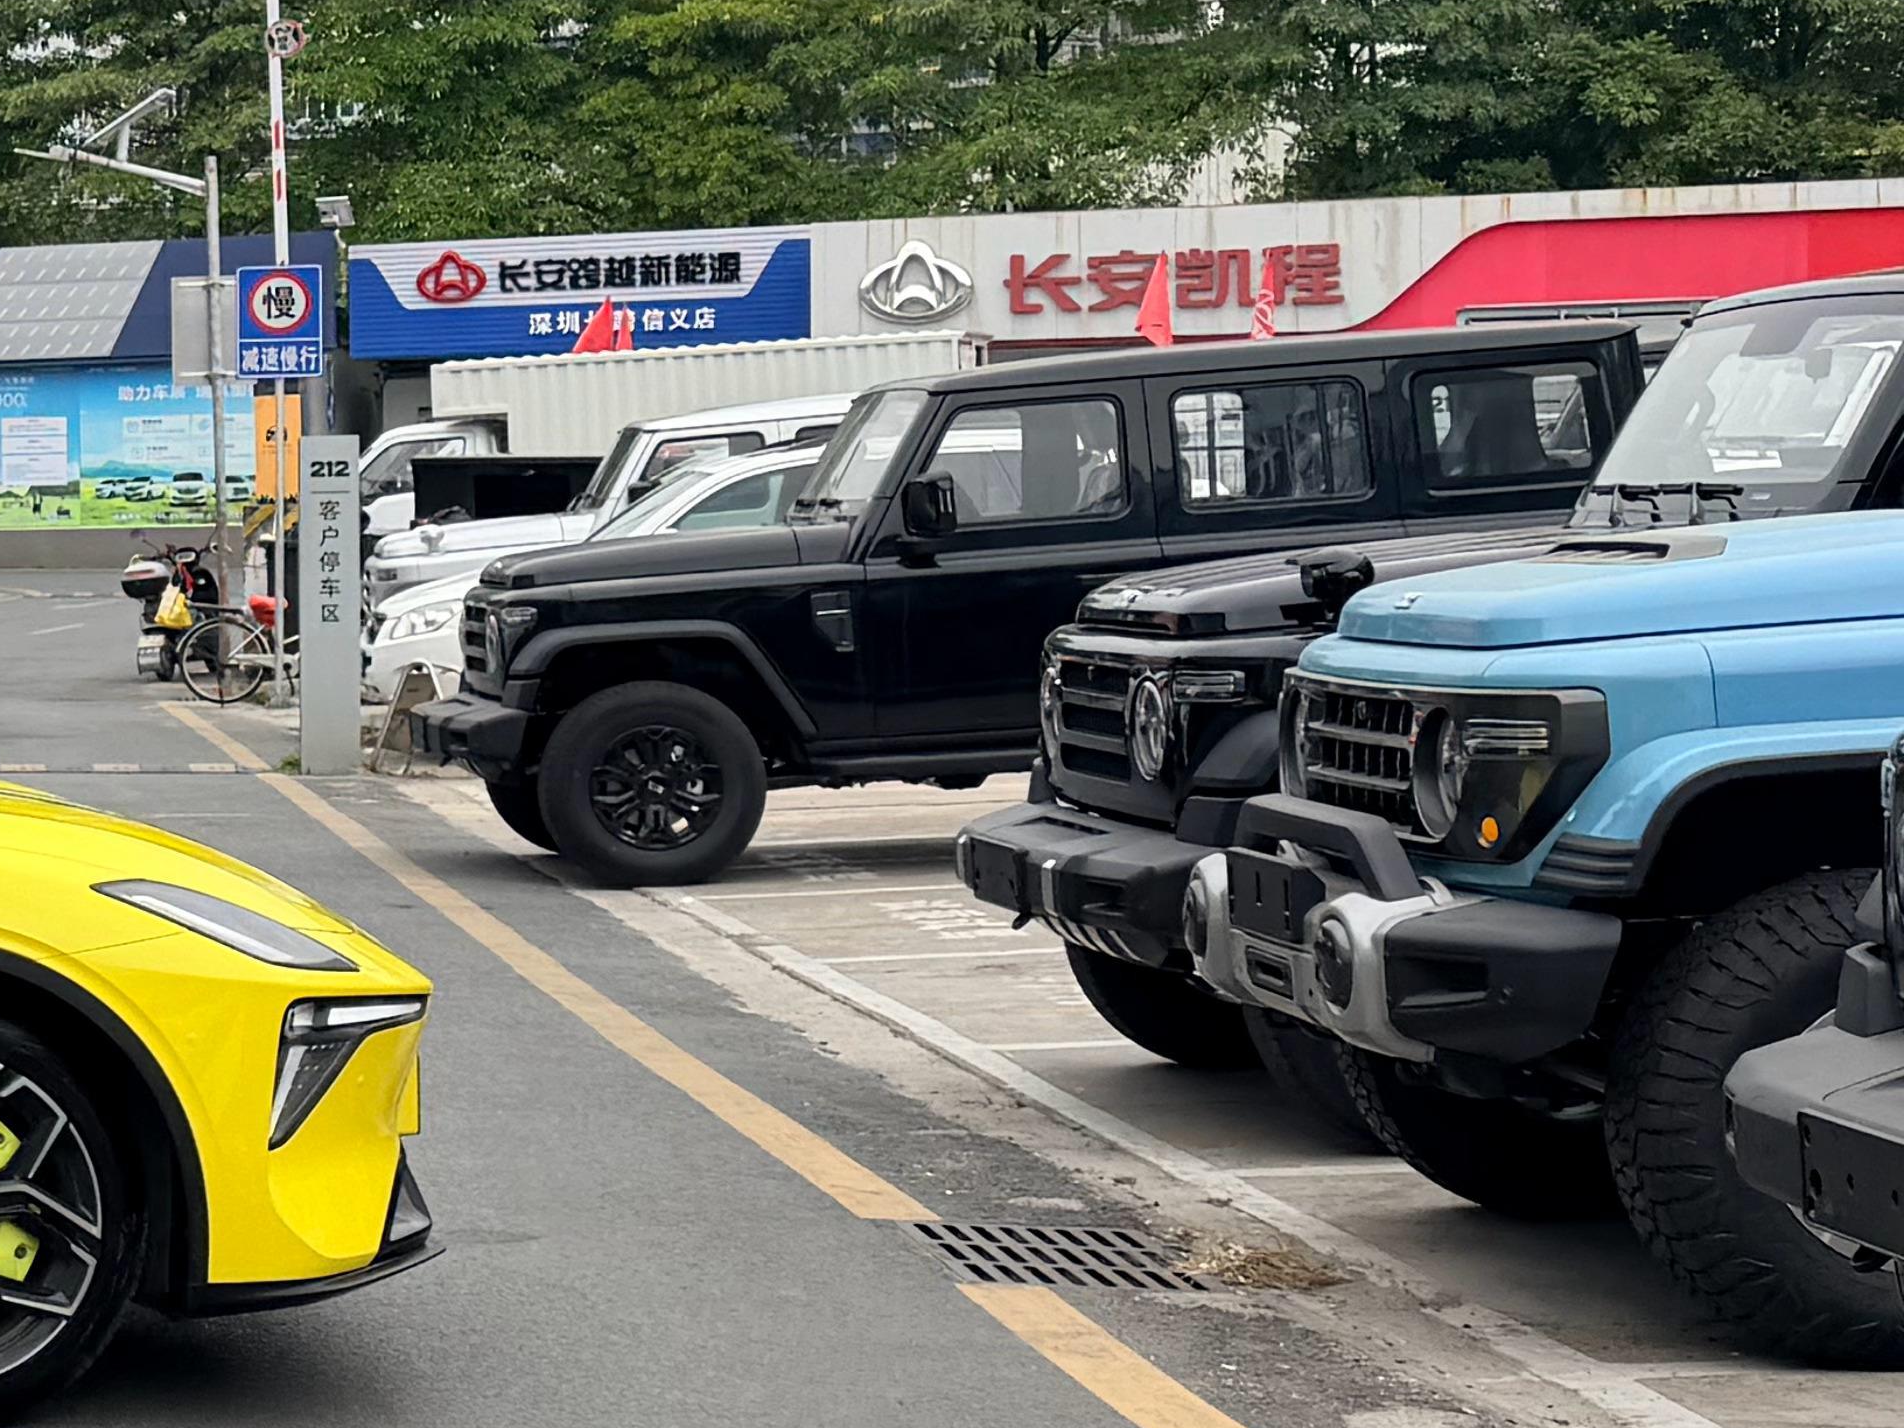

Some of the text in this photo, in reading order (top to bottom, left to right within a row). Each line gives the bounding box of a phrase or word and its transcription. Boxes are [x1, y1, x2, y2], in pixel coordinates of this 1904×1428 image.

[497, 251, 743, 294] 长安跨越新能源
[1003, 242, 1345, 315] 长安凯程
[261, 285, 297, 320] 慢
[241, 343, 320, 372] 减速慢行
[310, 459, 351, 478] 212
[318, 500, 341, 623] 客户停车区
